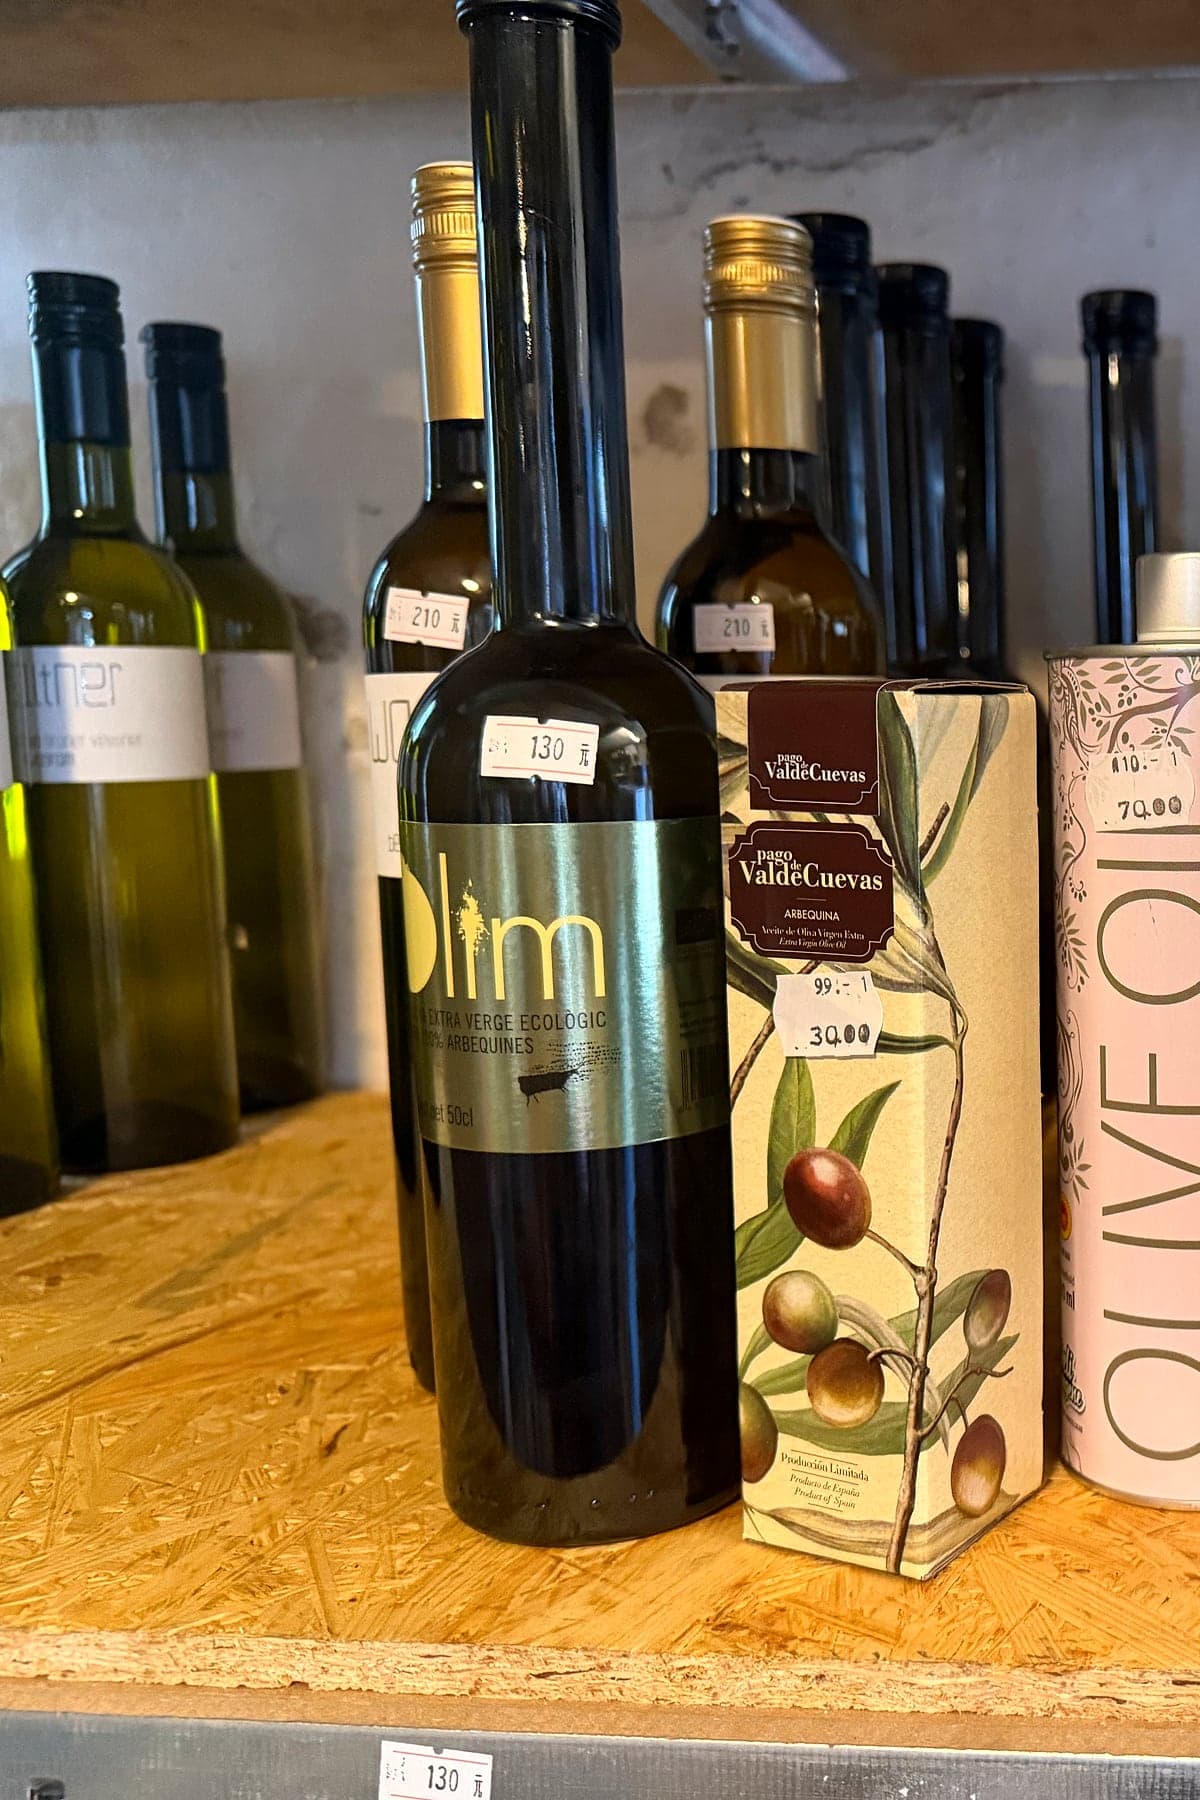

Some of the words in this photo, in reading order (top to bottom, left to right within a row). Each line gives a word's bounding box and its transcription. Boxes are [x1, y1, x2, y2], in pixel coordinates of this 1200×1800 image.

[412, 606, 441, 629] 210
[723, 618, 751, 637] 210
[530, 735, 565, 761] 130
[777, 753, 803, 767] pago
[764, 761, 867, 783] ValdeCuevas
[757, 849, 793, 866] pago
[790, 860, 802, 870] de
[739, 860, 883, 891] ValdeCuevas
[783, 909, 840, 921] ARBEQUINA
[761, 925, 785, 935] Aceite
[785, 926, 796, 936] de
[797, 927, 818, 938] Oliva
[817, 928, 843, 940] Virgen
[844, 929, 865, 941] Extra
[779, 937, 798, 947] Extra
[798, 938, 818, 949] Virgin
[428, 1010, 461, 1030] EXTRA
[466, 1013, 514, 1032] VERGE
[520, 1010, 607, 1031] ECOLÒGIC
[447, 1035, 534, 1054] ARBEQUINES
[446, 1104, 474, 1127] 50cl
[781, 1452, 829, 1473] Producción
[829, 1462, 869, 1483] Limitada
[789, 1473, 822, 1489] Producto
[822, 1479, 833, 1492] de
[832, 1481, 860, 1497] España
[794, 1487, 823, 1501] Product
[822, 1493, 832, 1506] of
[427, 1764, 459, 1792] 130
